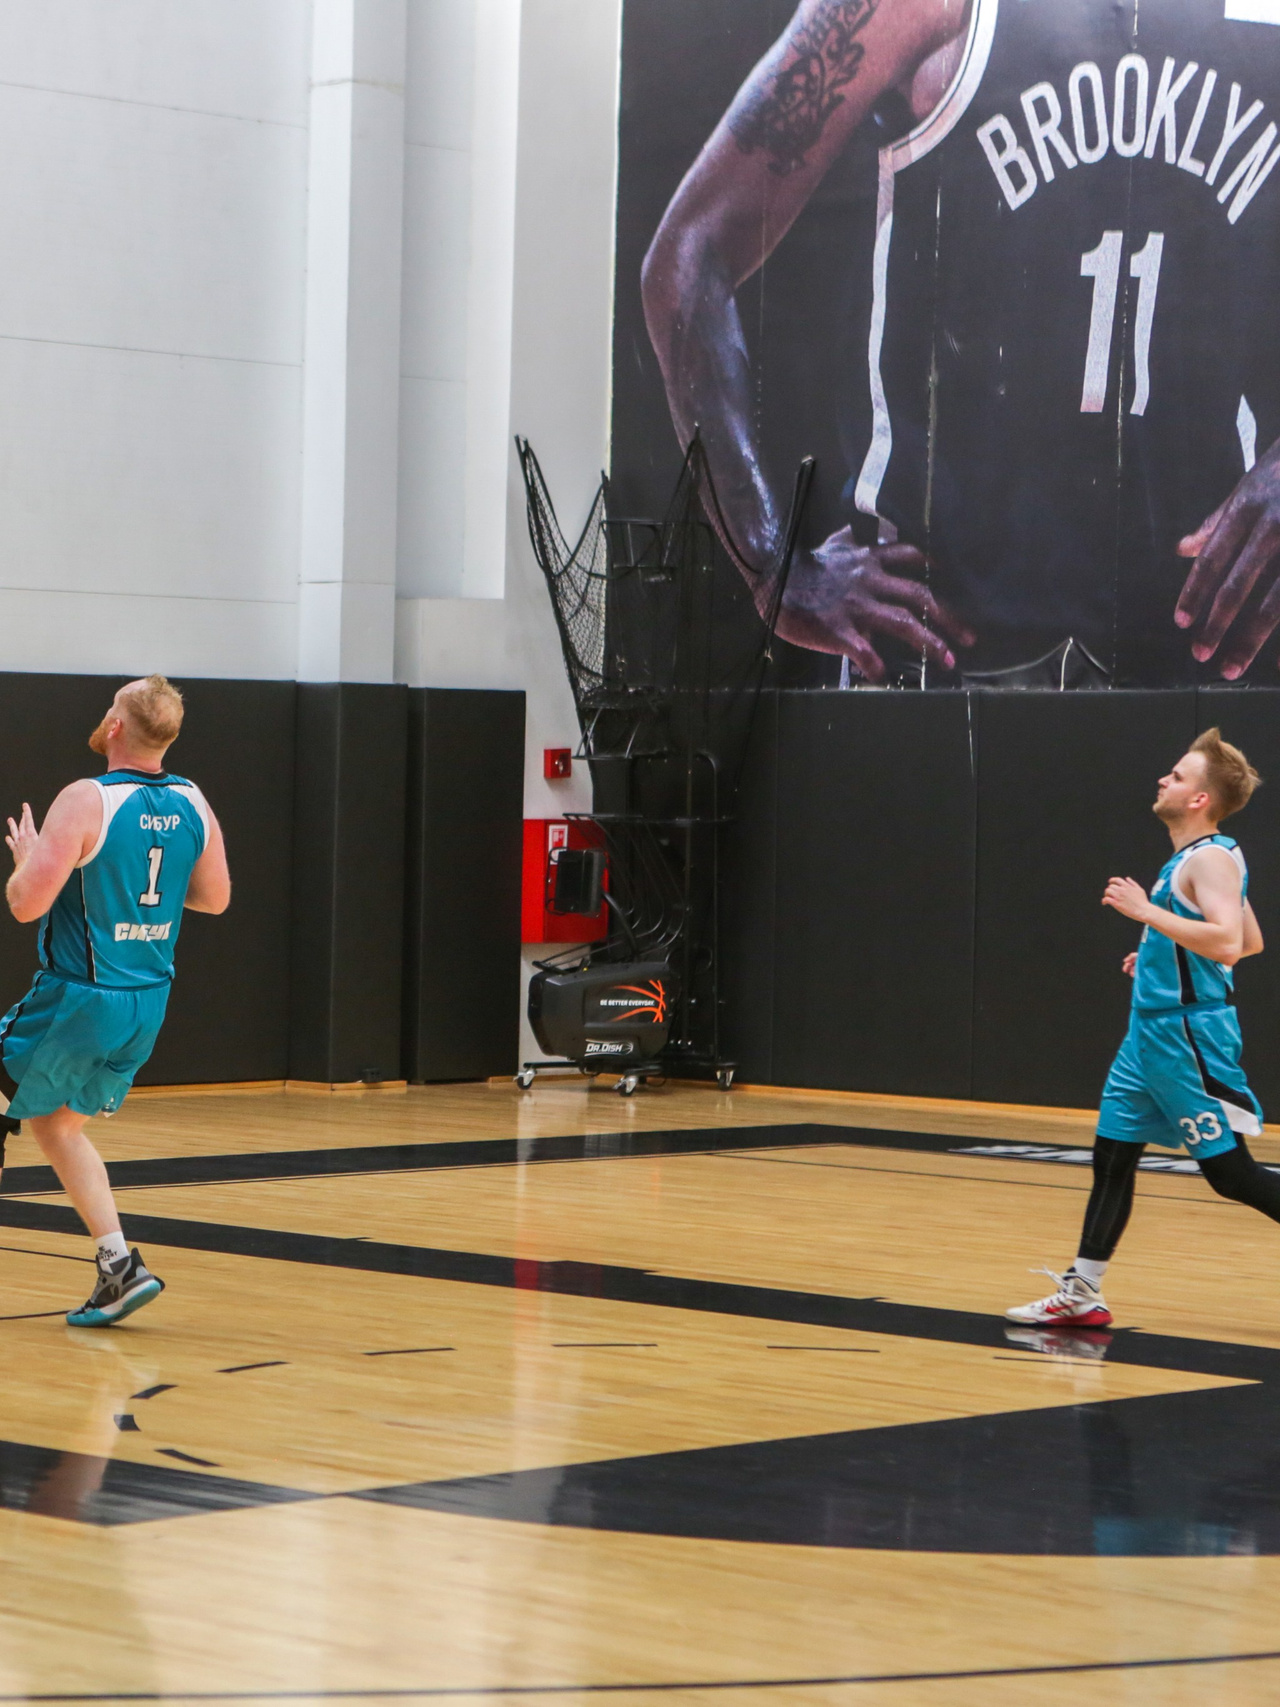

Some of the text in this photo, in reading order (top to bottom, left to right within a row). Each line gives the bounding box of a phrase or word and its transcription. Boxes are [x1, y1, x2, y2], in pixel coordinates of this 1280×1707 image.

[976, 53, 1280, 225] BROOKLYN
[1080, 230, 1164, 416] 11
[139, 814, 181, 831] СИБУР
[137, 845, 165, 907] 1
[1179, 1111, 1223, 1145] 33
